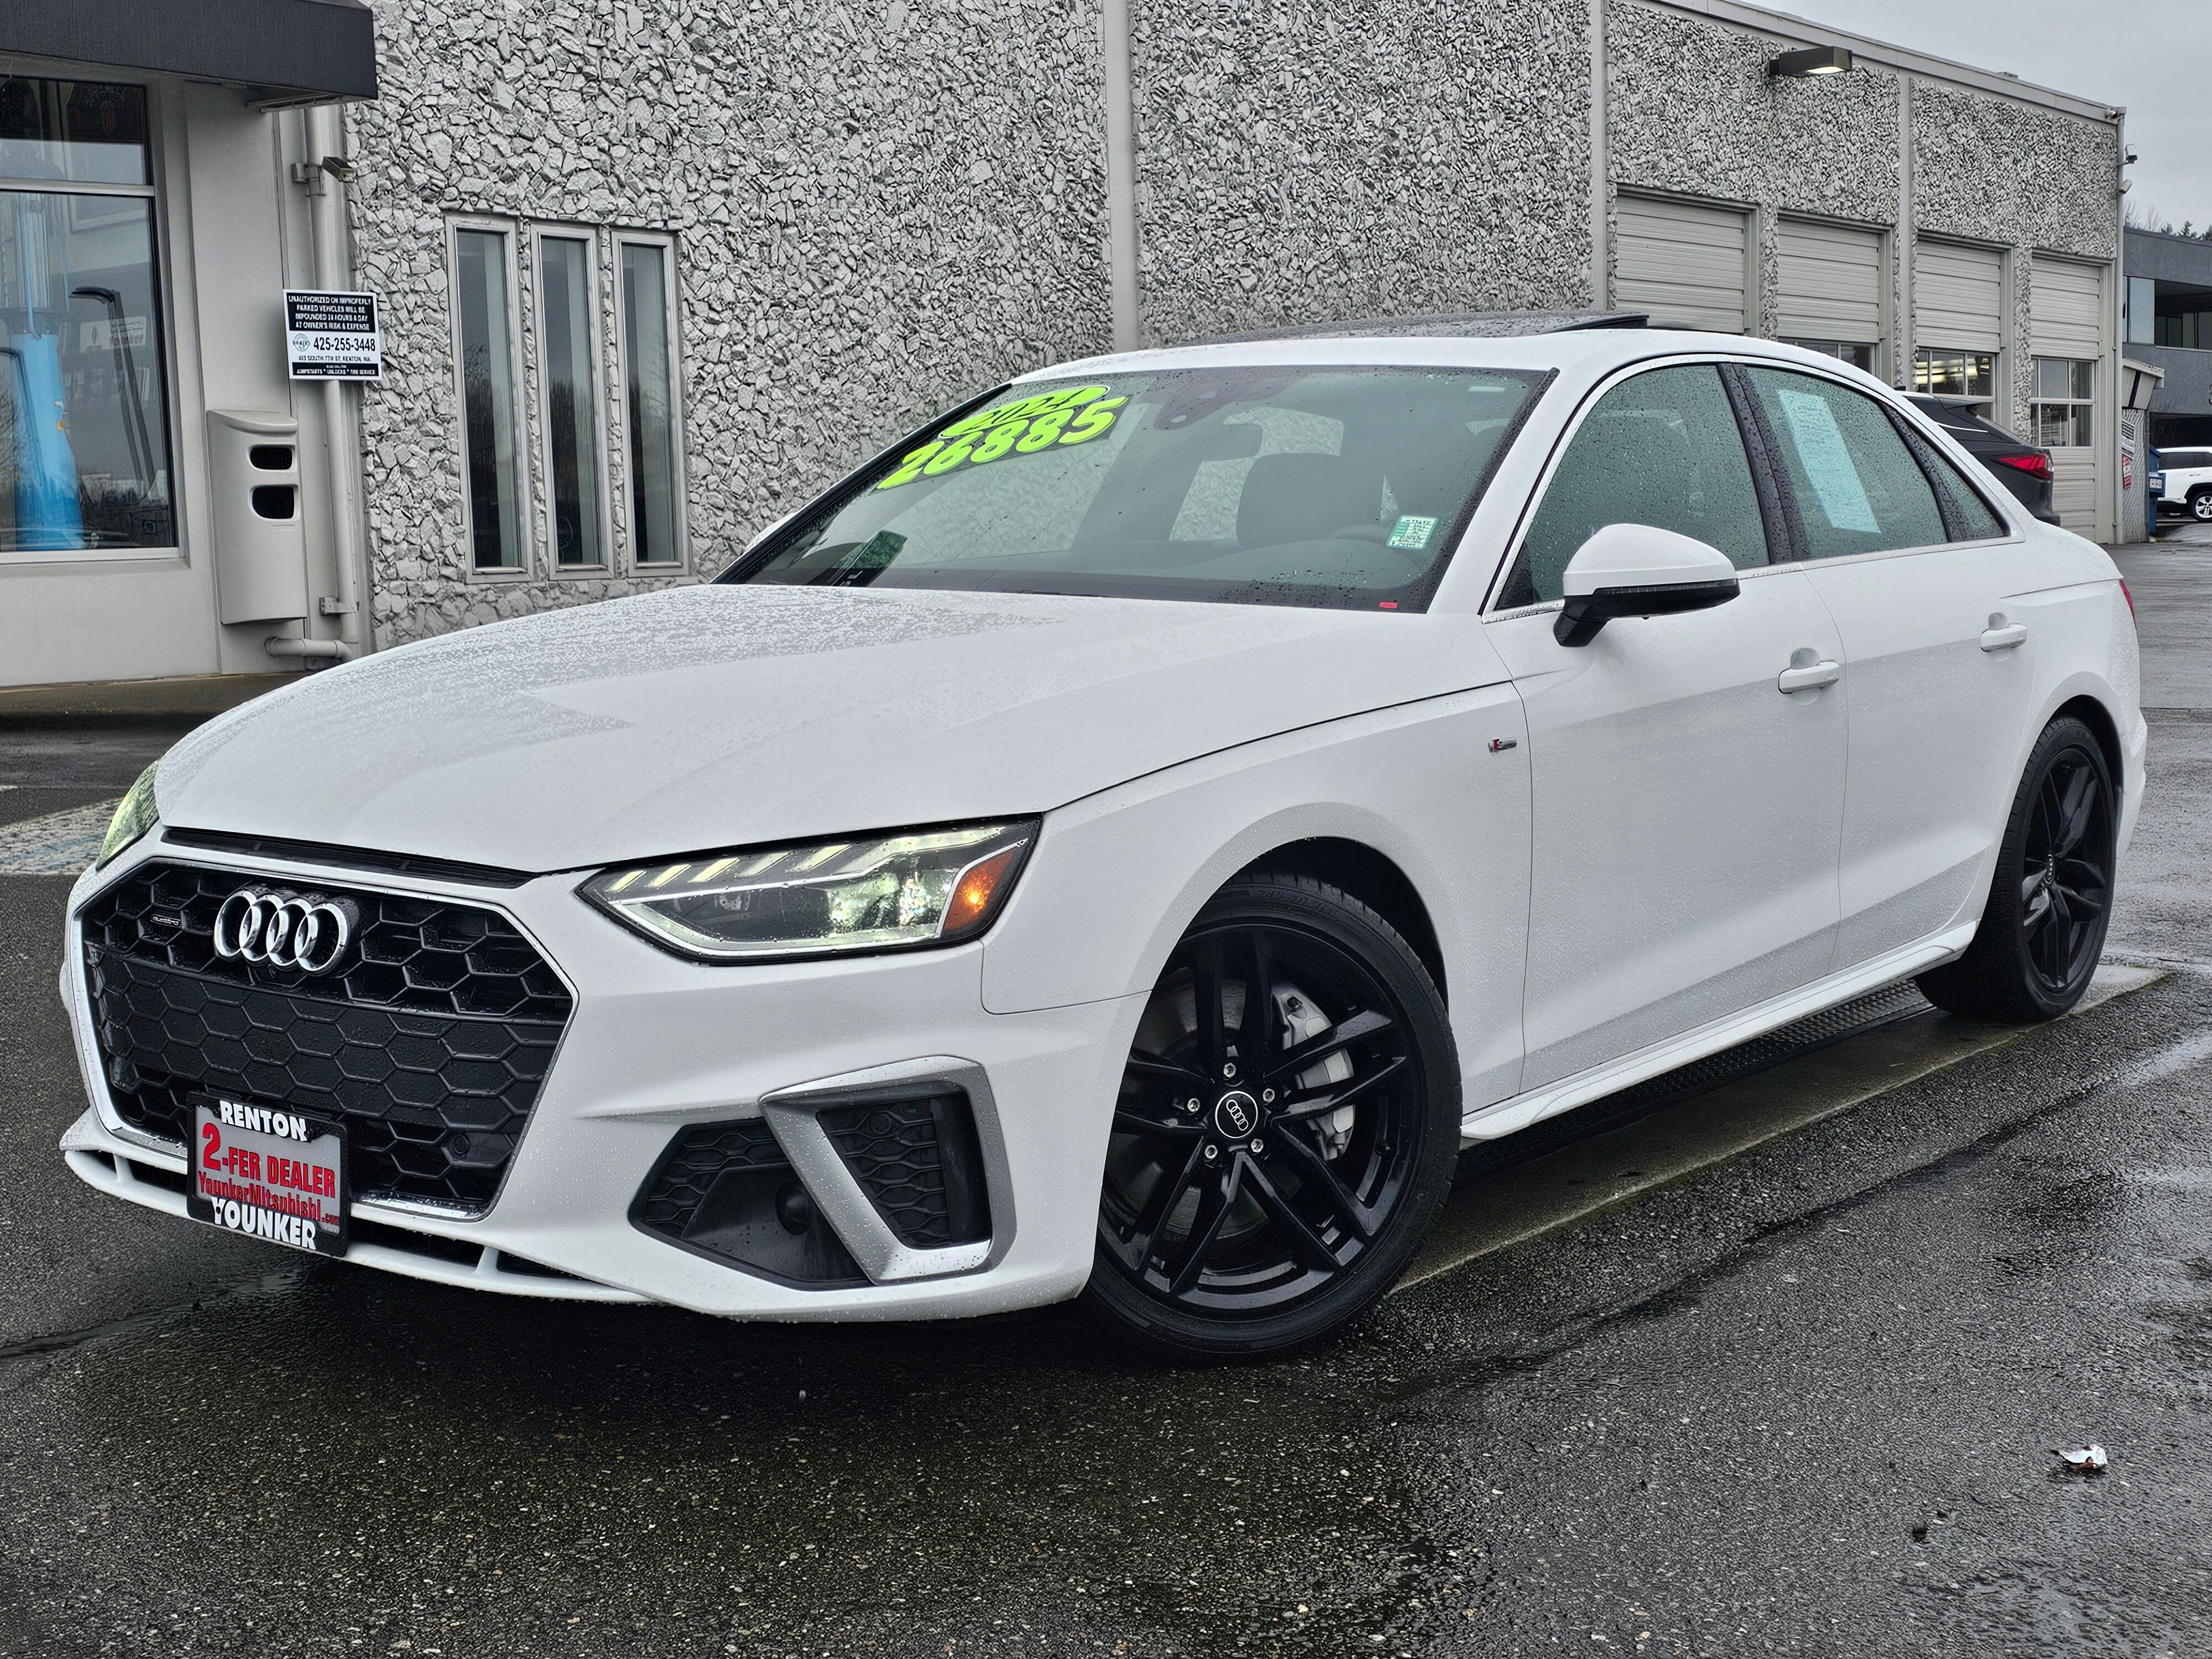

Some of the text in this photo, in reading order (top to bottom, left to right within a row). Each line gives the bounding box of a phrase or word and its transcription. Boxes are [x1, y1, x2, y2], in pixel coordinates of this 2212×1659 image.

[314, 337, 375, 352] 425-255-3448
[958, 388, 1089, 435] 2021
[875, 395, 1129, 490] 26885
[220, 1100, 308, 1142] RENTON
[202, 1123, 336, 1199] 2-FER DEALER
[211, 1196, 317, 1250] YOUNKER
